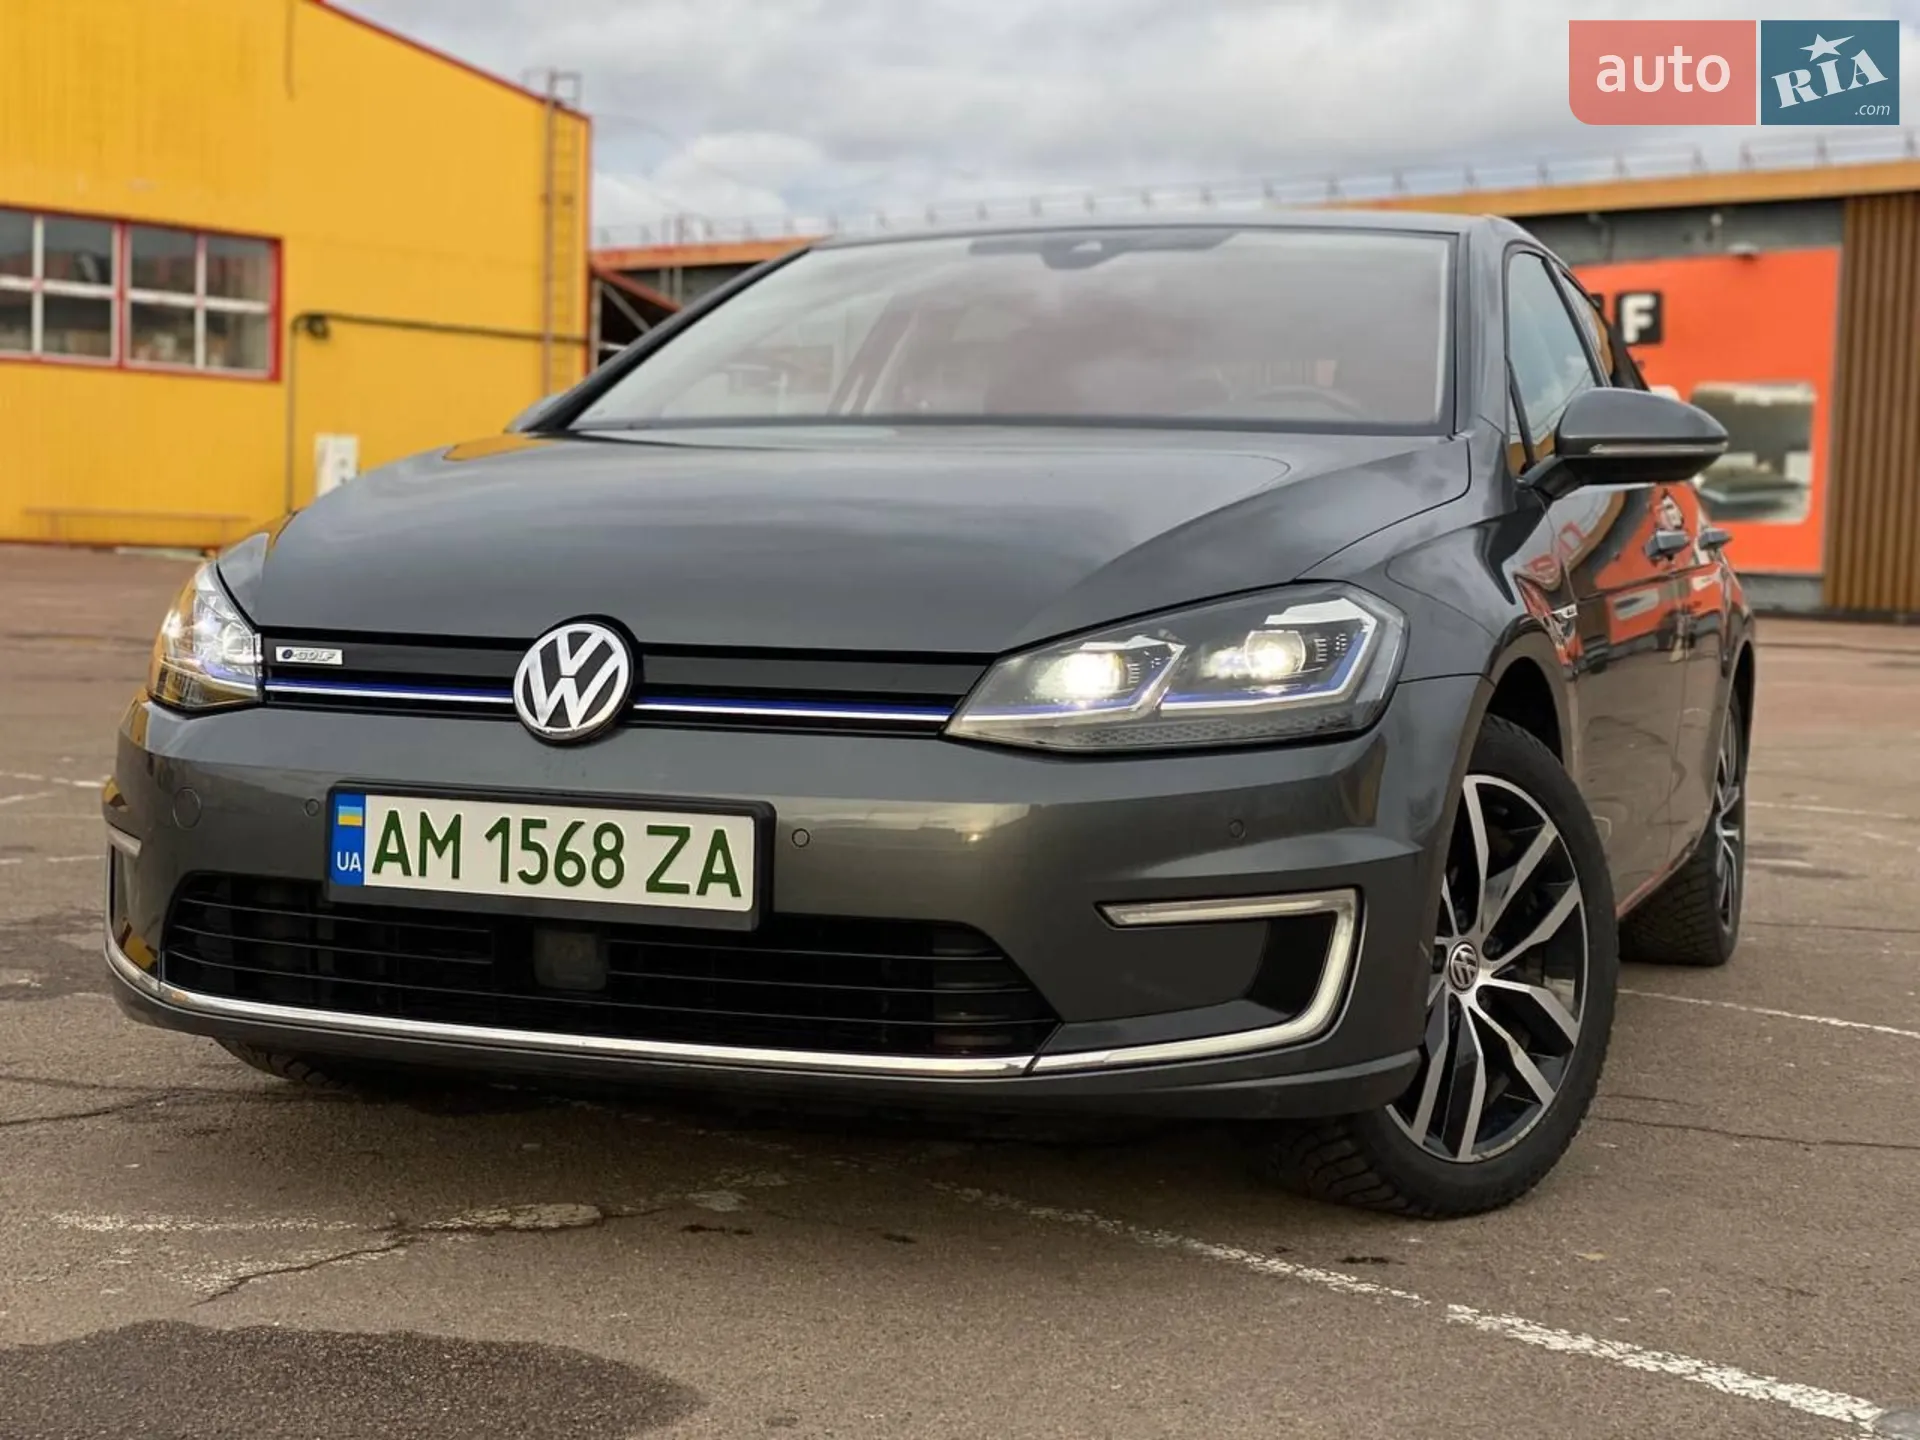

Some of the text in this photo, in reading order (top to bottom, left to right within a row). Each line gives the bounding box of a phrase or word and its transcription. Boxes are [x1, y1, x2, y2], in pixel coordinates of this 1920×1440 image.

[336, 851, 362, 873] UA
[371, 809, 742, 898] AM 1568 ZA
